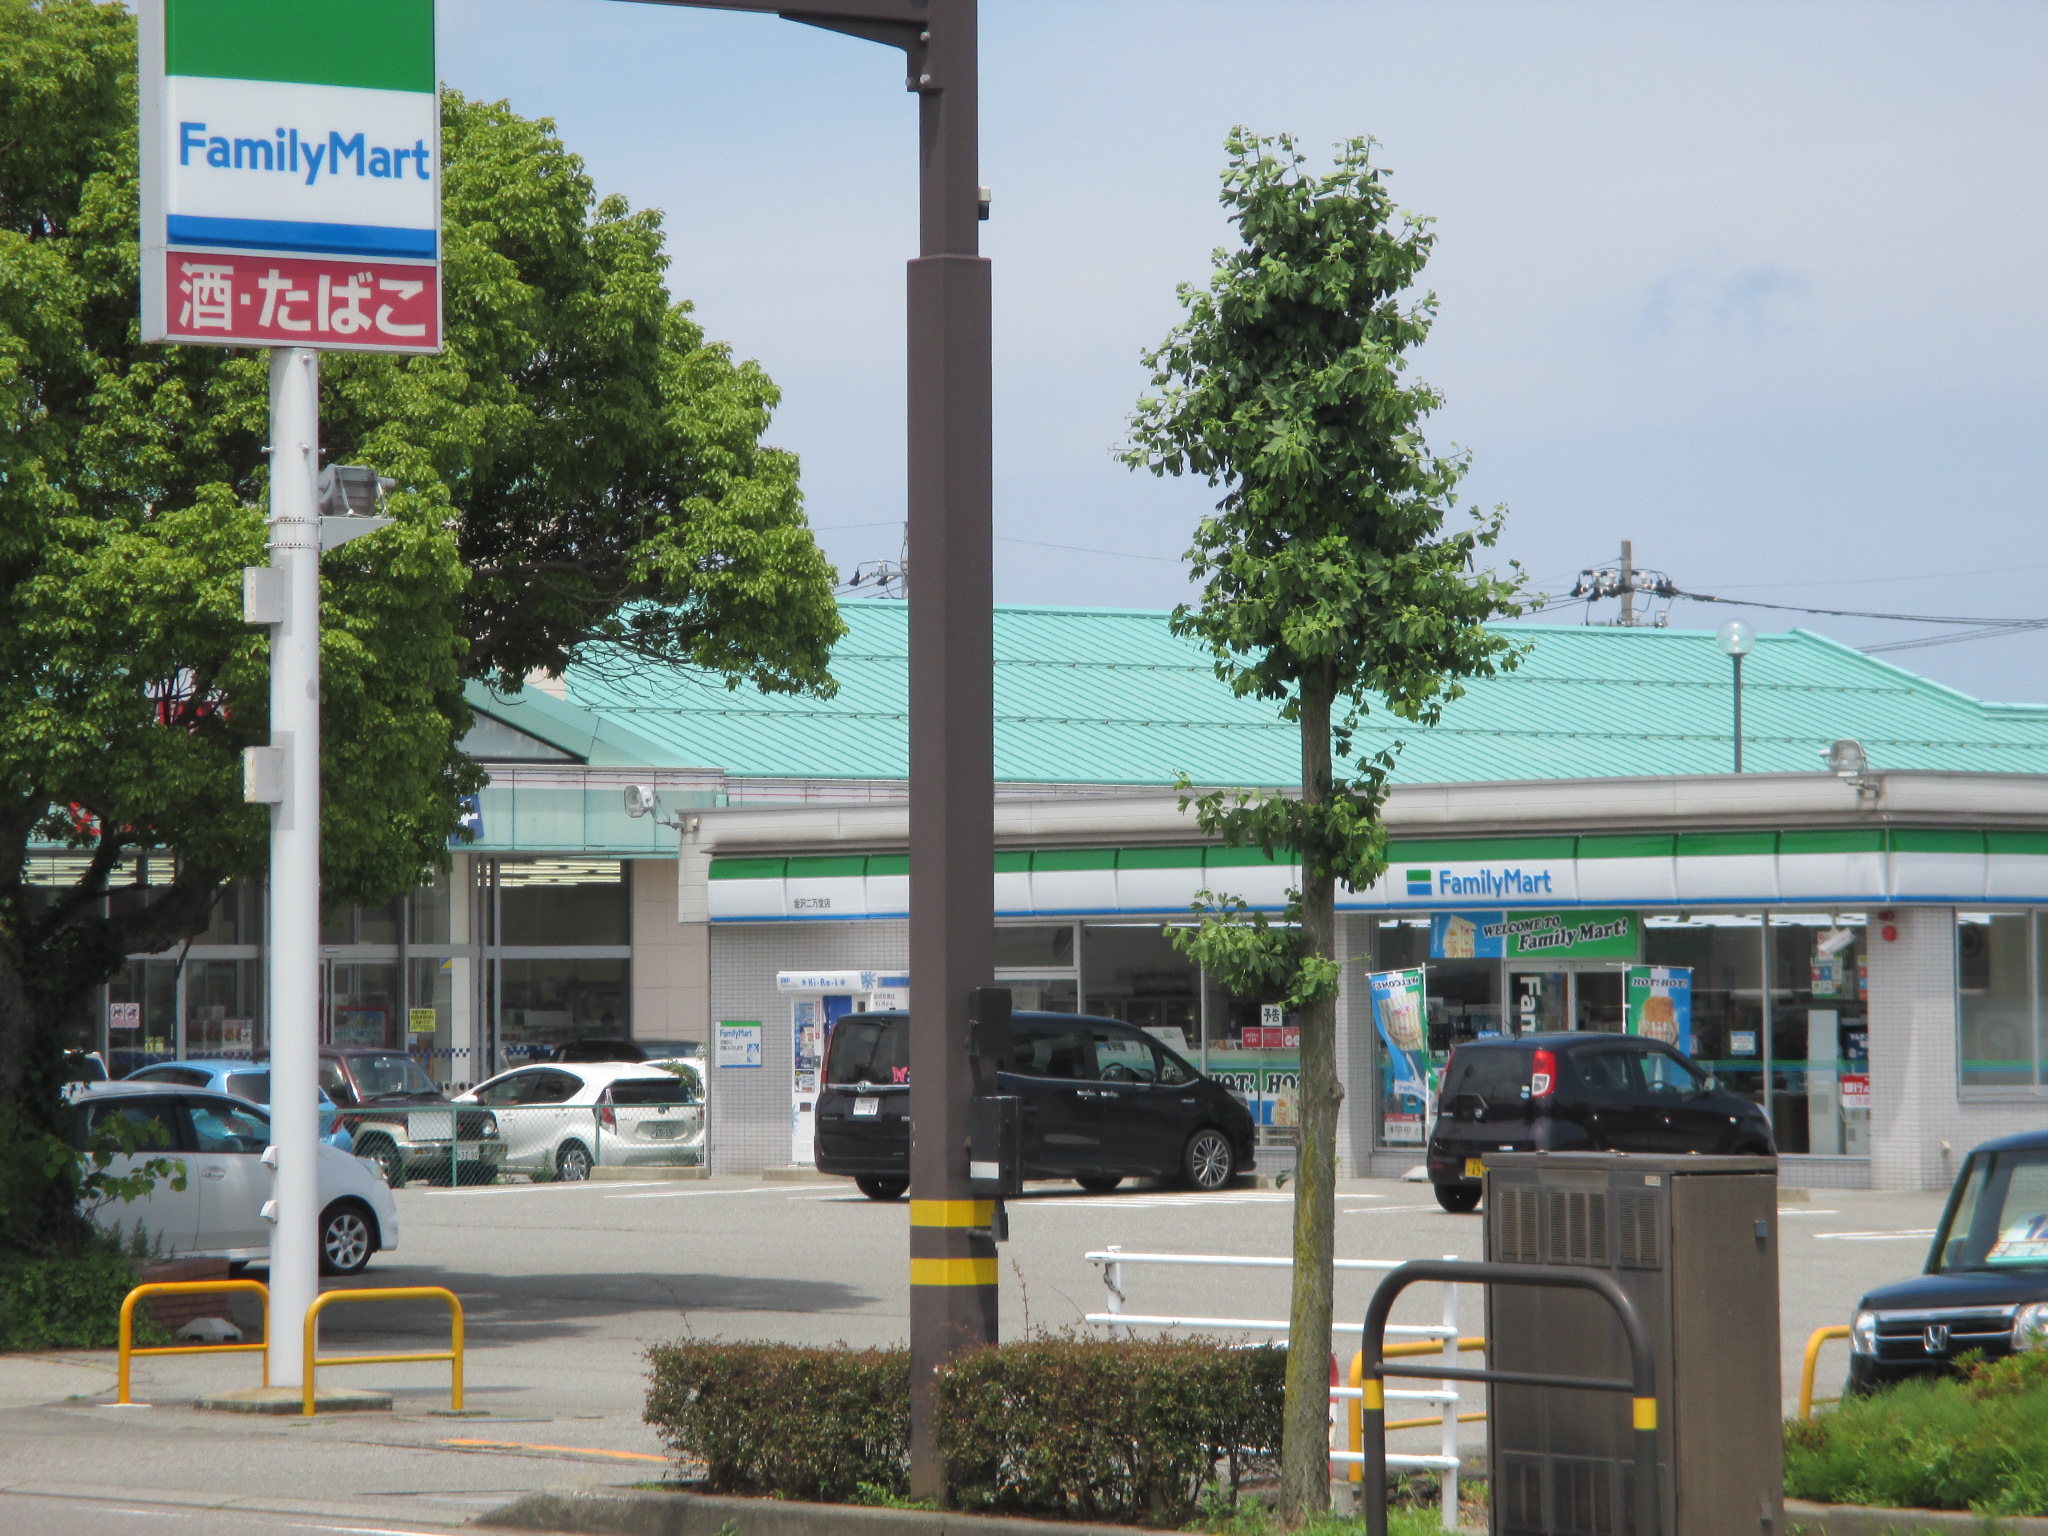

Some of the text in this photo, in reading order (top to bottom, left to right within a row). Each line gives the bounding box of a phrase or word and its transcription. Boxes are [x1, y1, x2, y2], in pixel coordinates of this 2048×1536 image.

[179, 121, 430, 186] FamilyMart
[1439, 867, 1553, 898] FamilyMart
[1483, 915, 1561, 938] WELCOME TO
[1517, 916, 1629, 952] Family Mart!
[1632, 977, 1688, 989] HOT! HOT!
[1263, 1007, 1281, 1023] 予告
[719, 1029, 753, 1040] FamilyMart
[1265, 1072, 1300, 1094] HO
